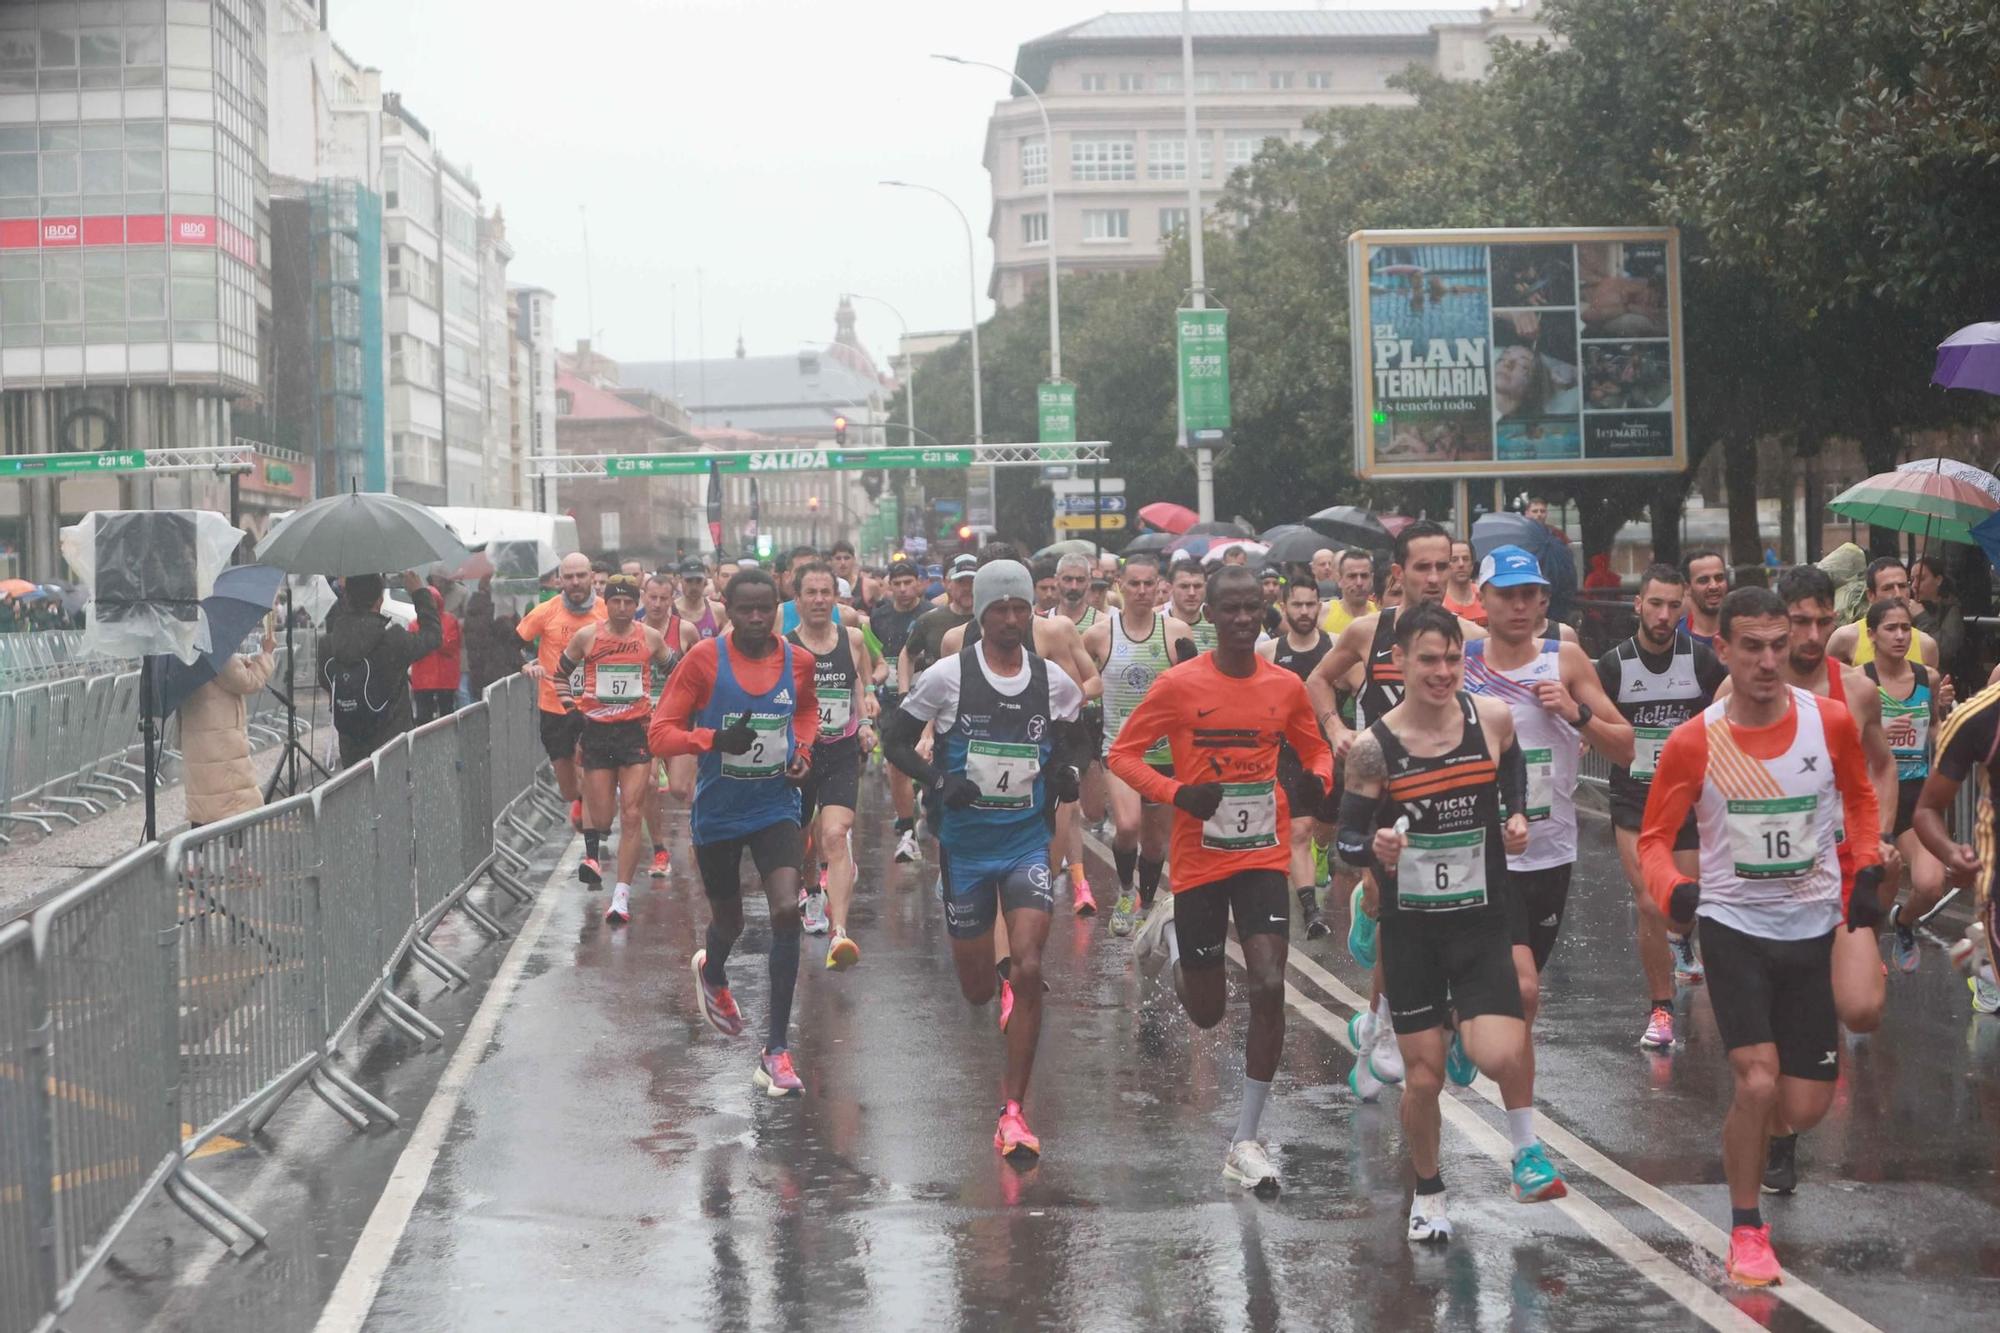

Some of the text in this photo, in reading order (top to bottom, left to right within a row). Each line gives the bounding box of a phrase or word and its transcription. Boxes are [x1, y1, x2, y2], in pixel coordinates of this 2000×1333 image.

[1375, 324, 1399, 339] EL
[1374, 338, 1486, 369] PLAN
[1375, 368, 1488, 398] TERMARIA
[1395, 399, 1441, 411] tenerlo
[1443, 399, 1477, 411] todo.
[639, 459, 654, 470] 5K
[748, 450, 829, 471] SALIDA
[612, 680, 627, 695] 57
[752, 743, 764, 764] 2
[996, 770, 1010, 793] 4
[1434, 794, 1478, 812] VICKY
[1236, 809, 1249, 833] 3
[1438, 807, 1474, 821] FOODS
[1761, 829, 1791, 859] 16
[1435, 862, 1449, 890] 6
